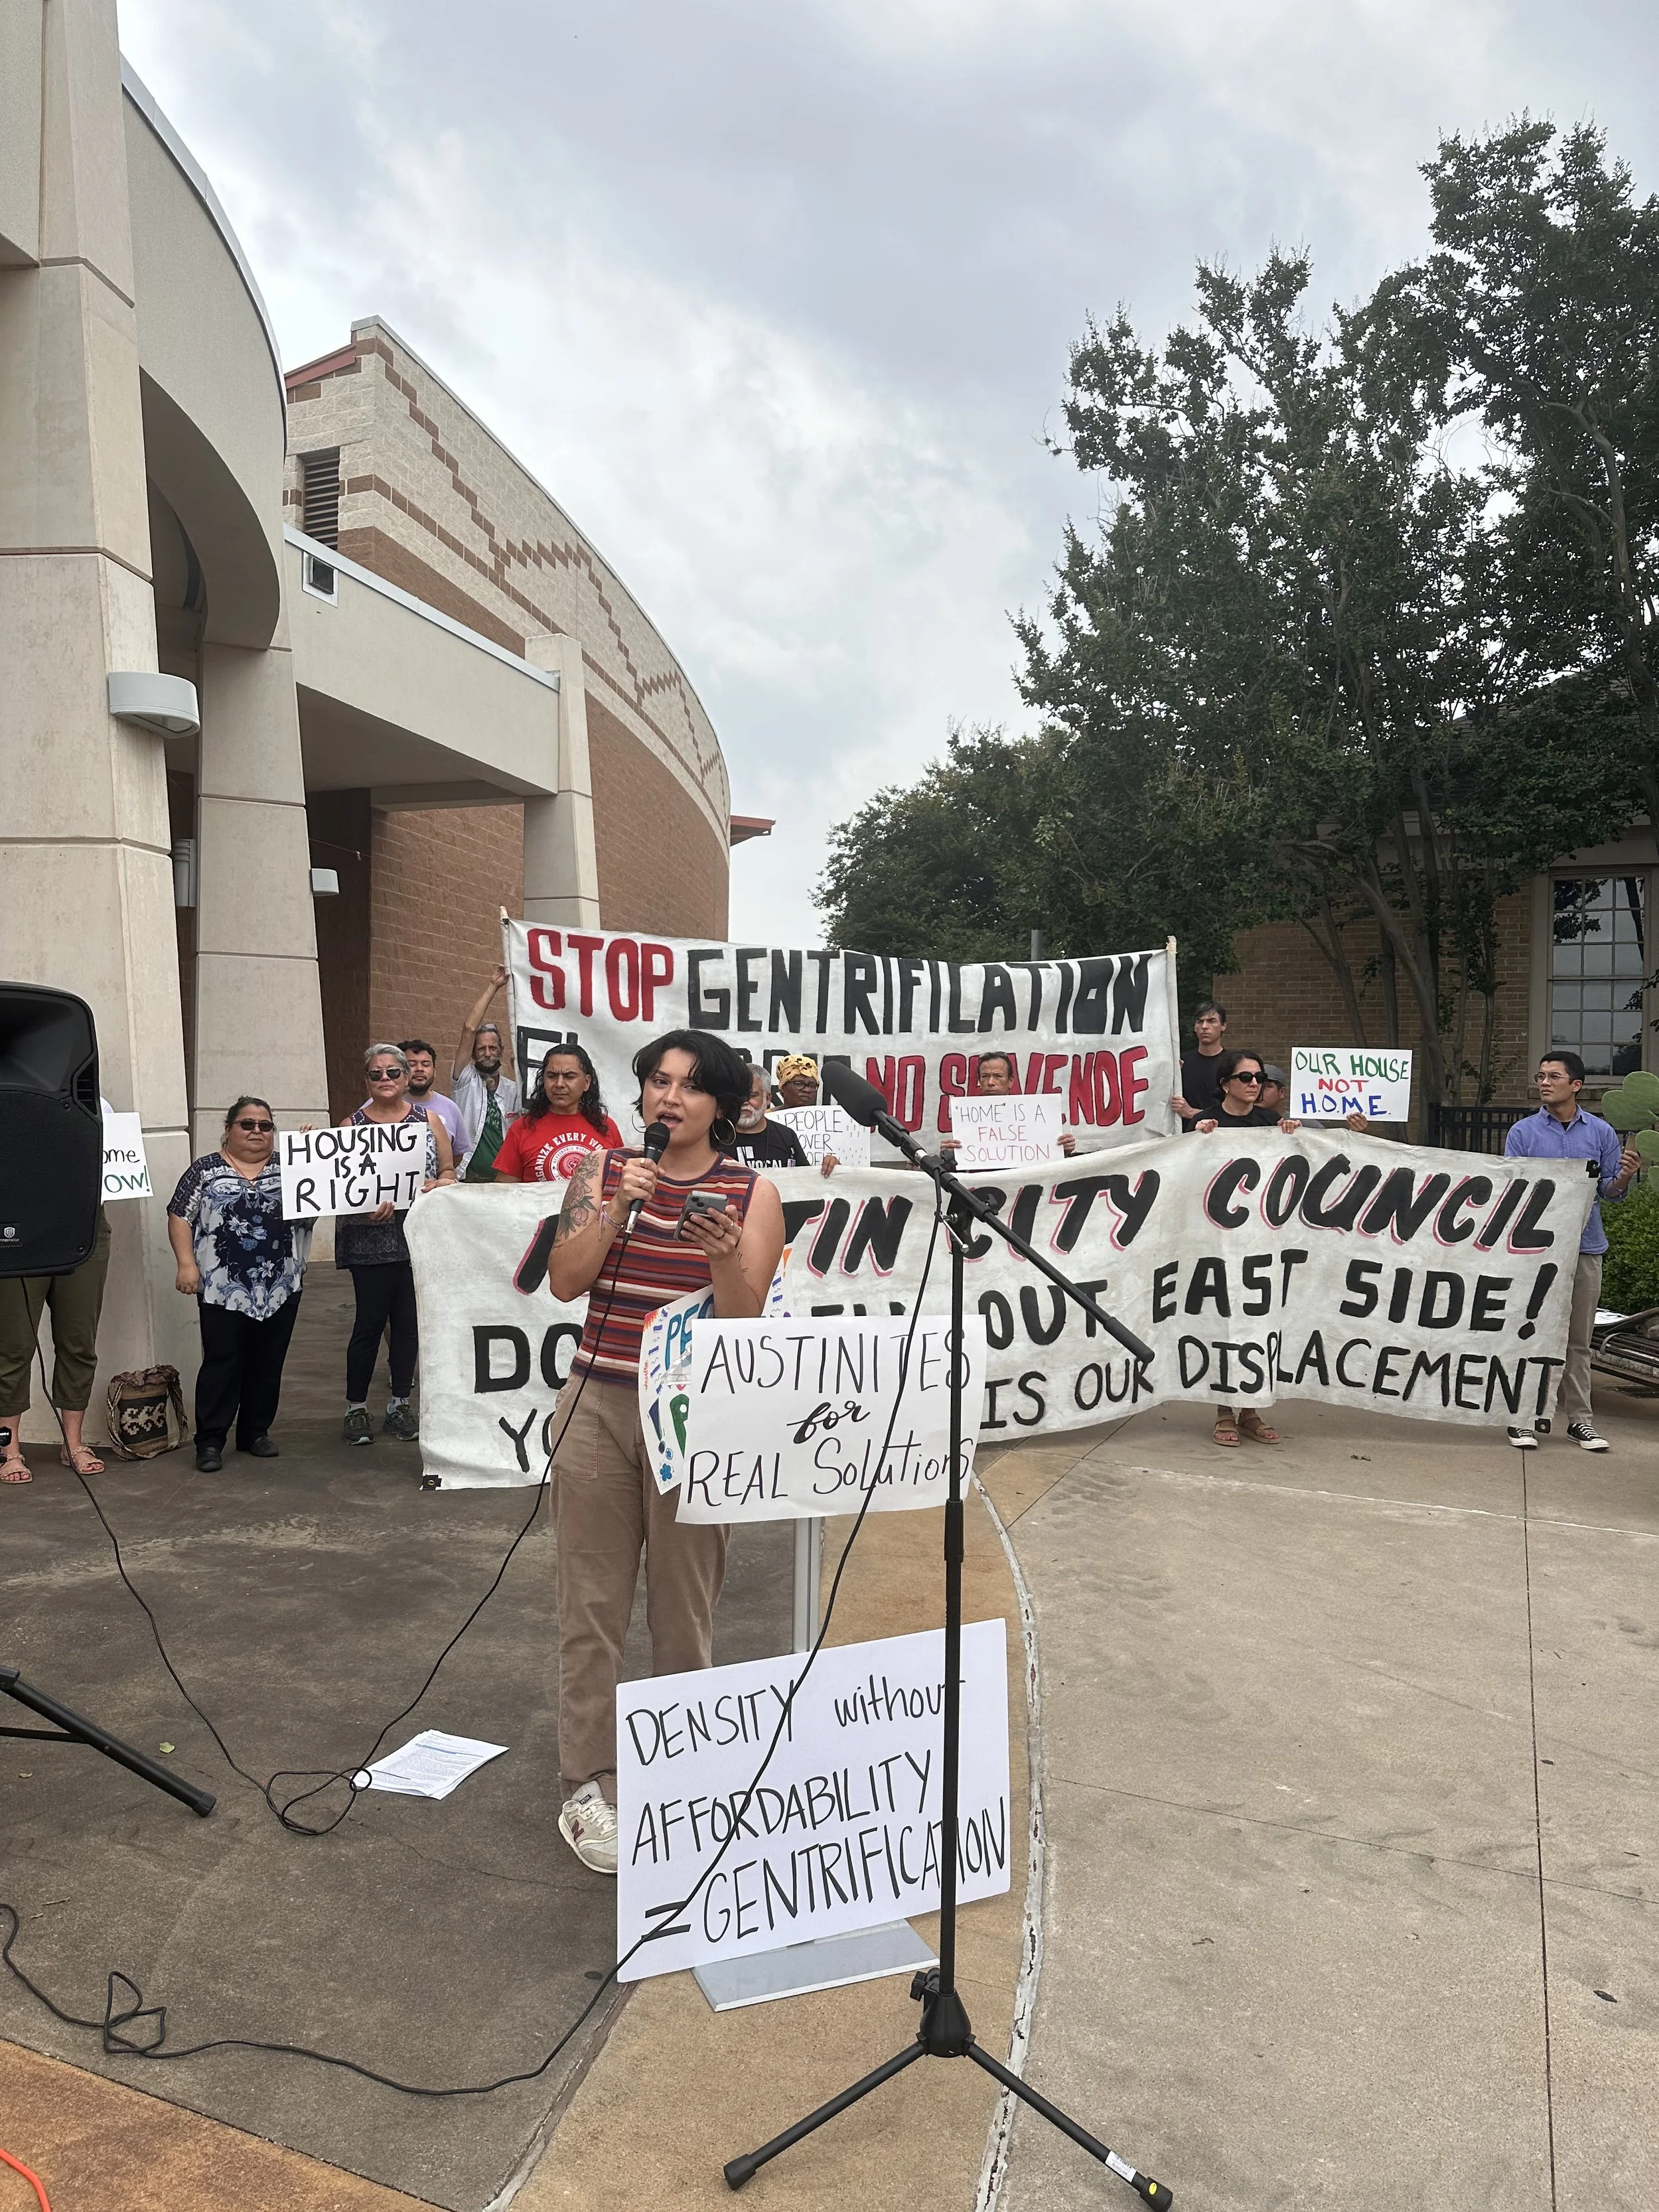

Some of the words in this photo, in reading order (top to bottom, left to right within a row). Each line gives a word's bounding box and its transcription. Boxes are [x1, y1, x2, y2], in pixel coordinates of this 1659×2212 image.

[527, 928, 674, 1021] STOP
[1295, 1051, 1341, 1075] OUR
[1350, 1055, 1409, 1082] HOUSE
[1318, 1078, 1369, 1093] NOT
[784, 1110, 843, 1133] PEOPLE
[978, 1124, 1027, 1142] FALSE
[1014, 1104, 1025, 1122] IS
[1035, 1104, 1046, 1123] A
[288, 1124, 417, 1165] HOUSING
[552, 1132, 587, 1146] EVERY
[964, 1143, 1050, 1162] SOLUTION
[334, 1155, 351, 1179] IS
[358, 1153, 376, 1176] A
[946, 1169, 1161, 1262] CITY
[1203, 1153, 1557, 1254] COUNCIL
[978, 1280, 1108, 1350] OUT
[1153, 1248, 1309, 1323] EAST
[1339, 1258, 1558, 1340] SIDE!
[1074, 1357, 1153, 1410] OUR
[786, 1400, 871, 1444] for
[687, 1450, 788, 1507] REAL
[626, 1680, 796, 1766] DENSITY
[834, 1674, 966, 1728] withou
[632, 1750, 931, 1866] AFFORDABILITY
